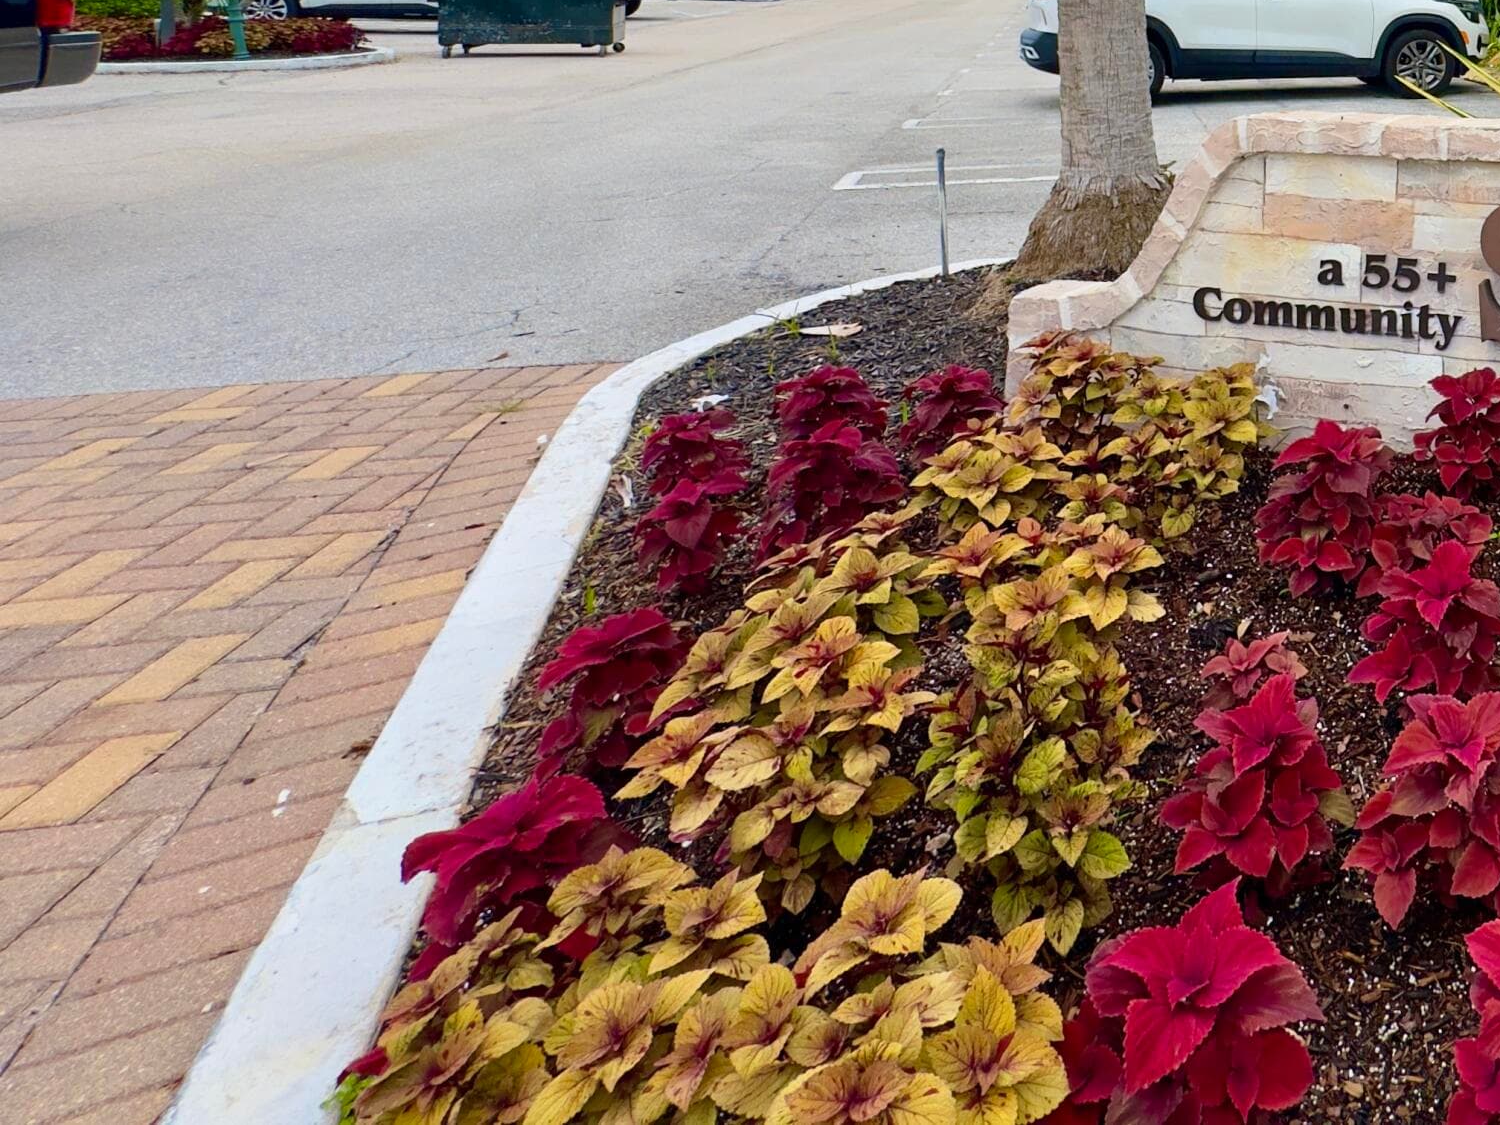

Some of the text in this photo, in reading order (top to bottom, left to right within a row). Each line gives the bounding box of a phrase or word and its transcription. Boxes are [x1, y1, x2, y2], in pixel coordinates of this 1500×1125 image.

[1317, 254, 1457, 294] a 55+
[1193, 286, 1463, 351] Community
